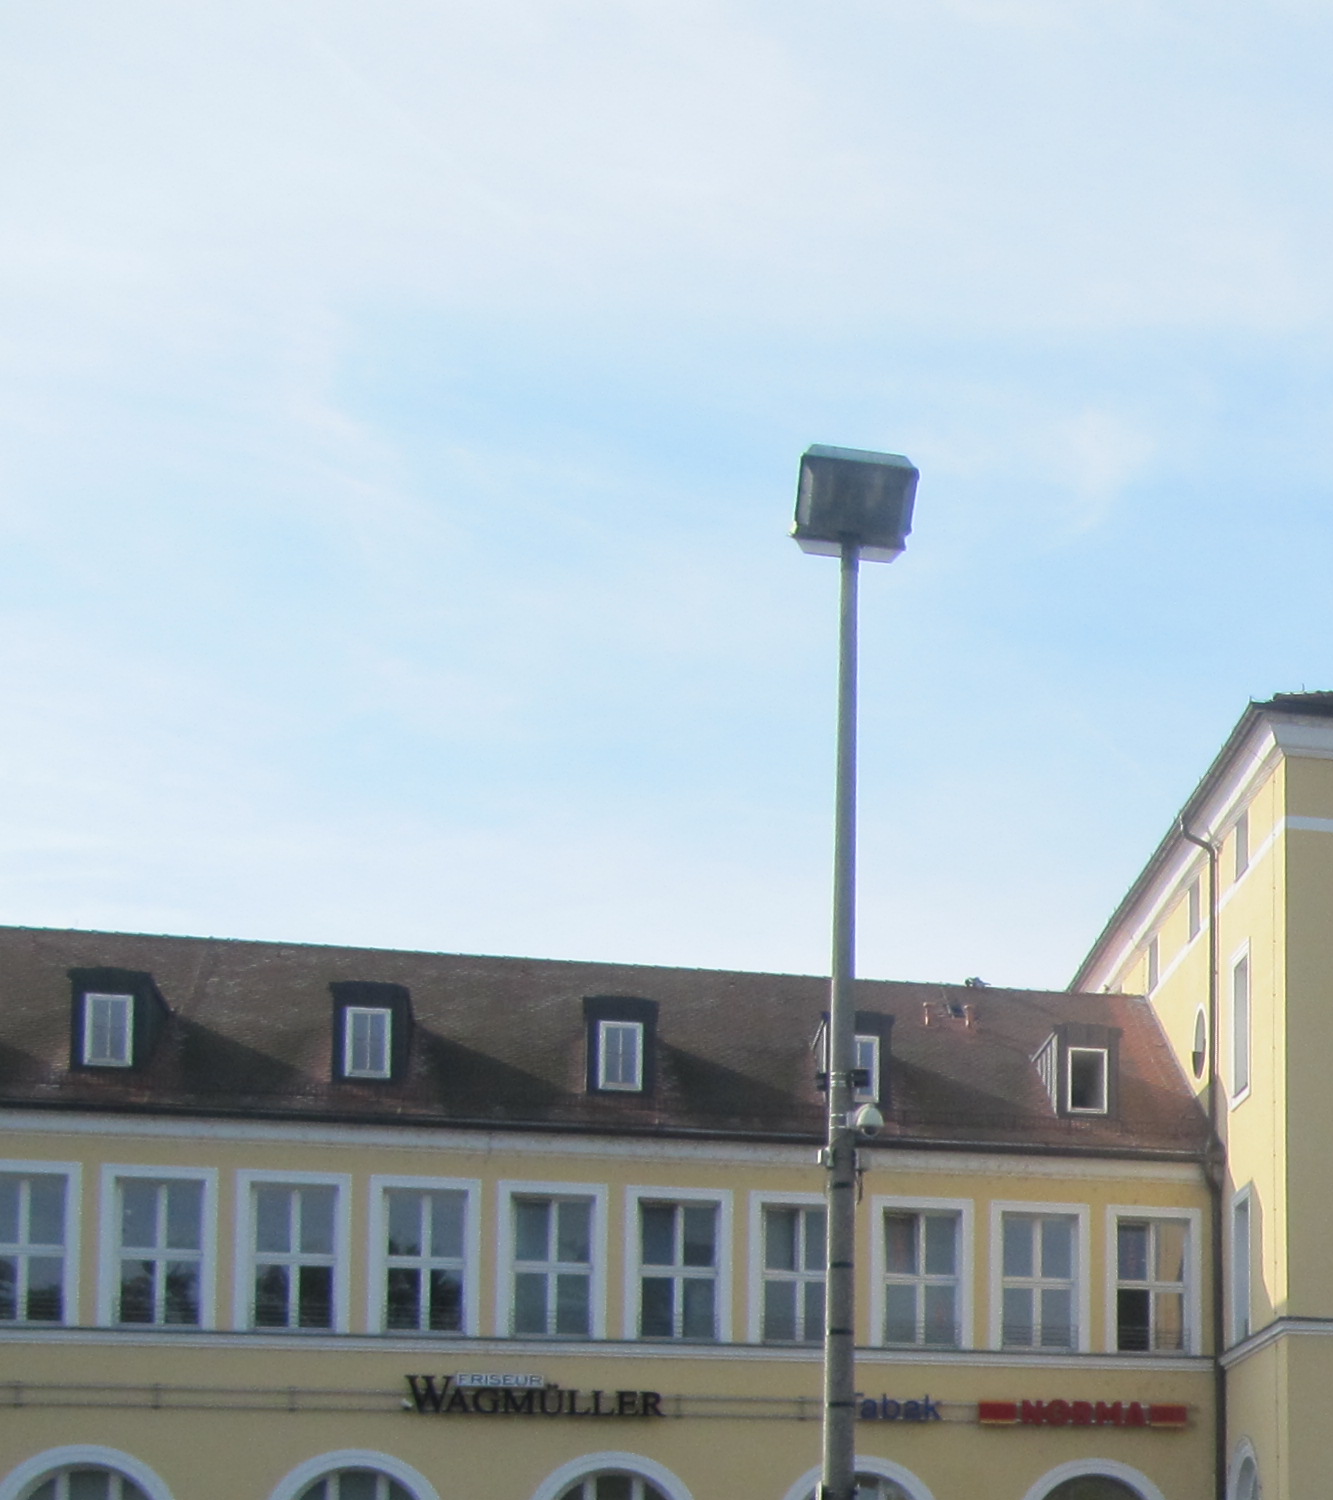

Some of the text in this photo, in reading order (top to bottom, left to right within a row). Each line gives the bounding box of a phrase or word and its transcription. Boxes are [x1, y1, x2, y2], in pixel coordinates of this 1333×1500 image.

[457, 1373, 543, 1386] FRISEUR
[405, 1374, 666, 1417] WAGMÜLLER
[1021, 1399, 1147, 1427] NORMA
